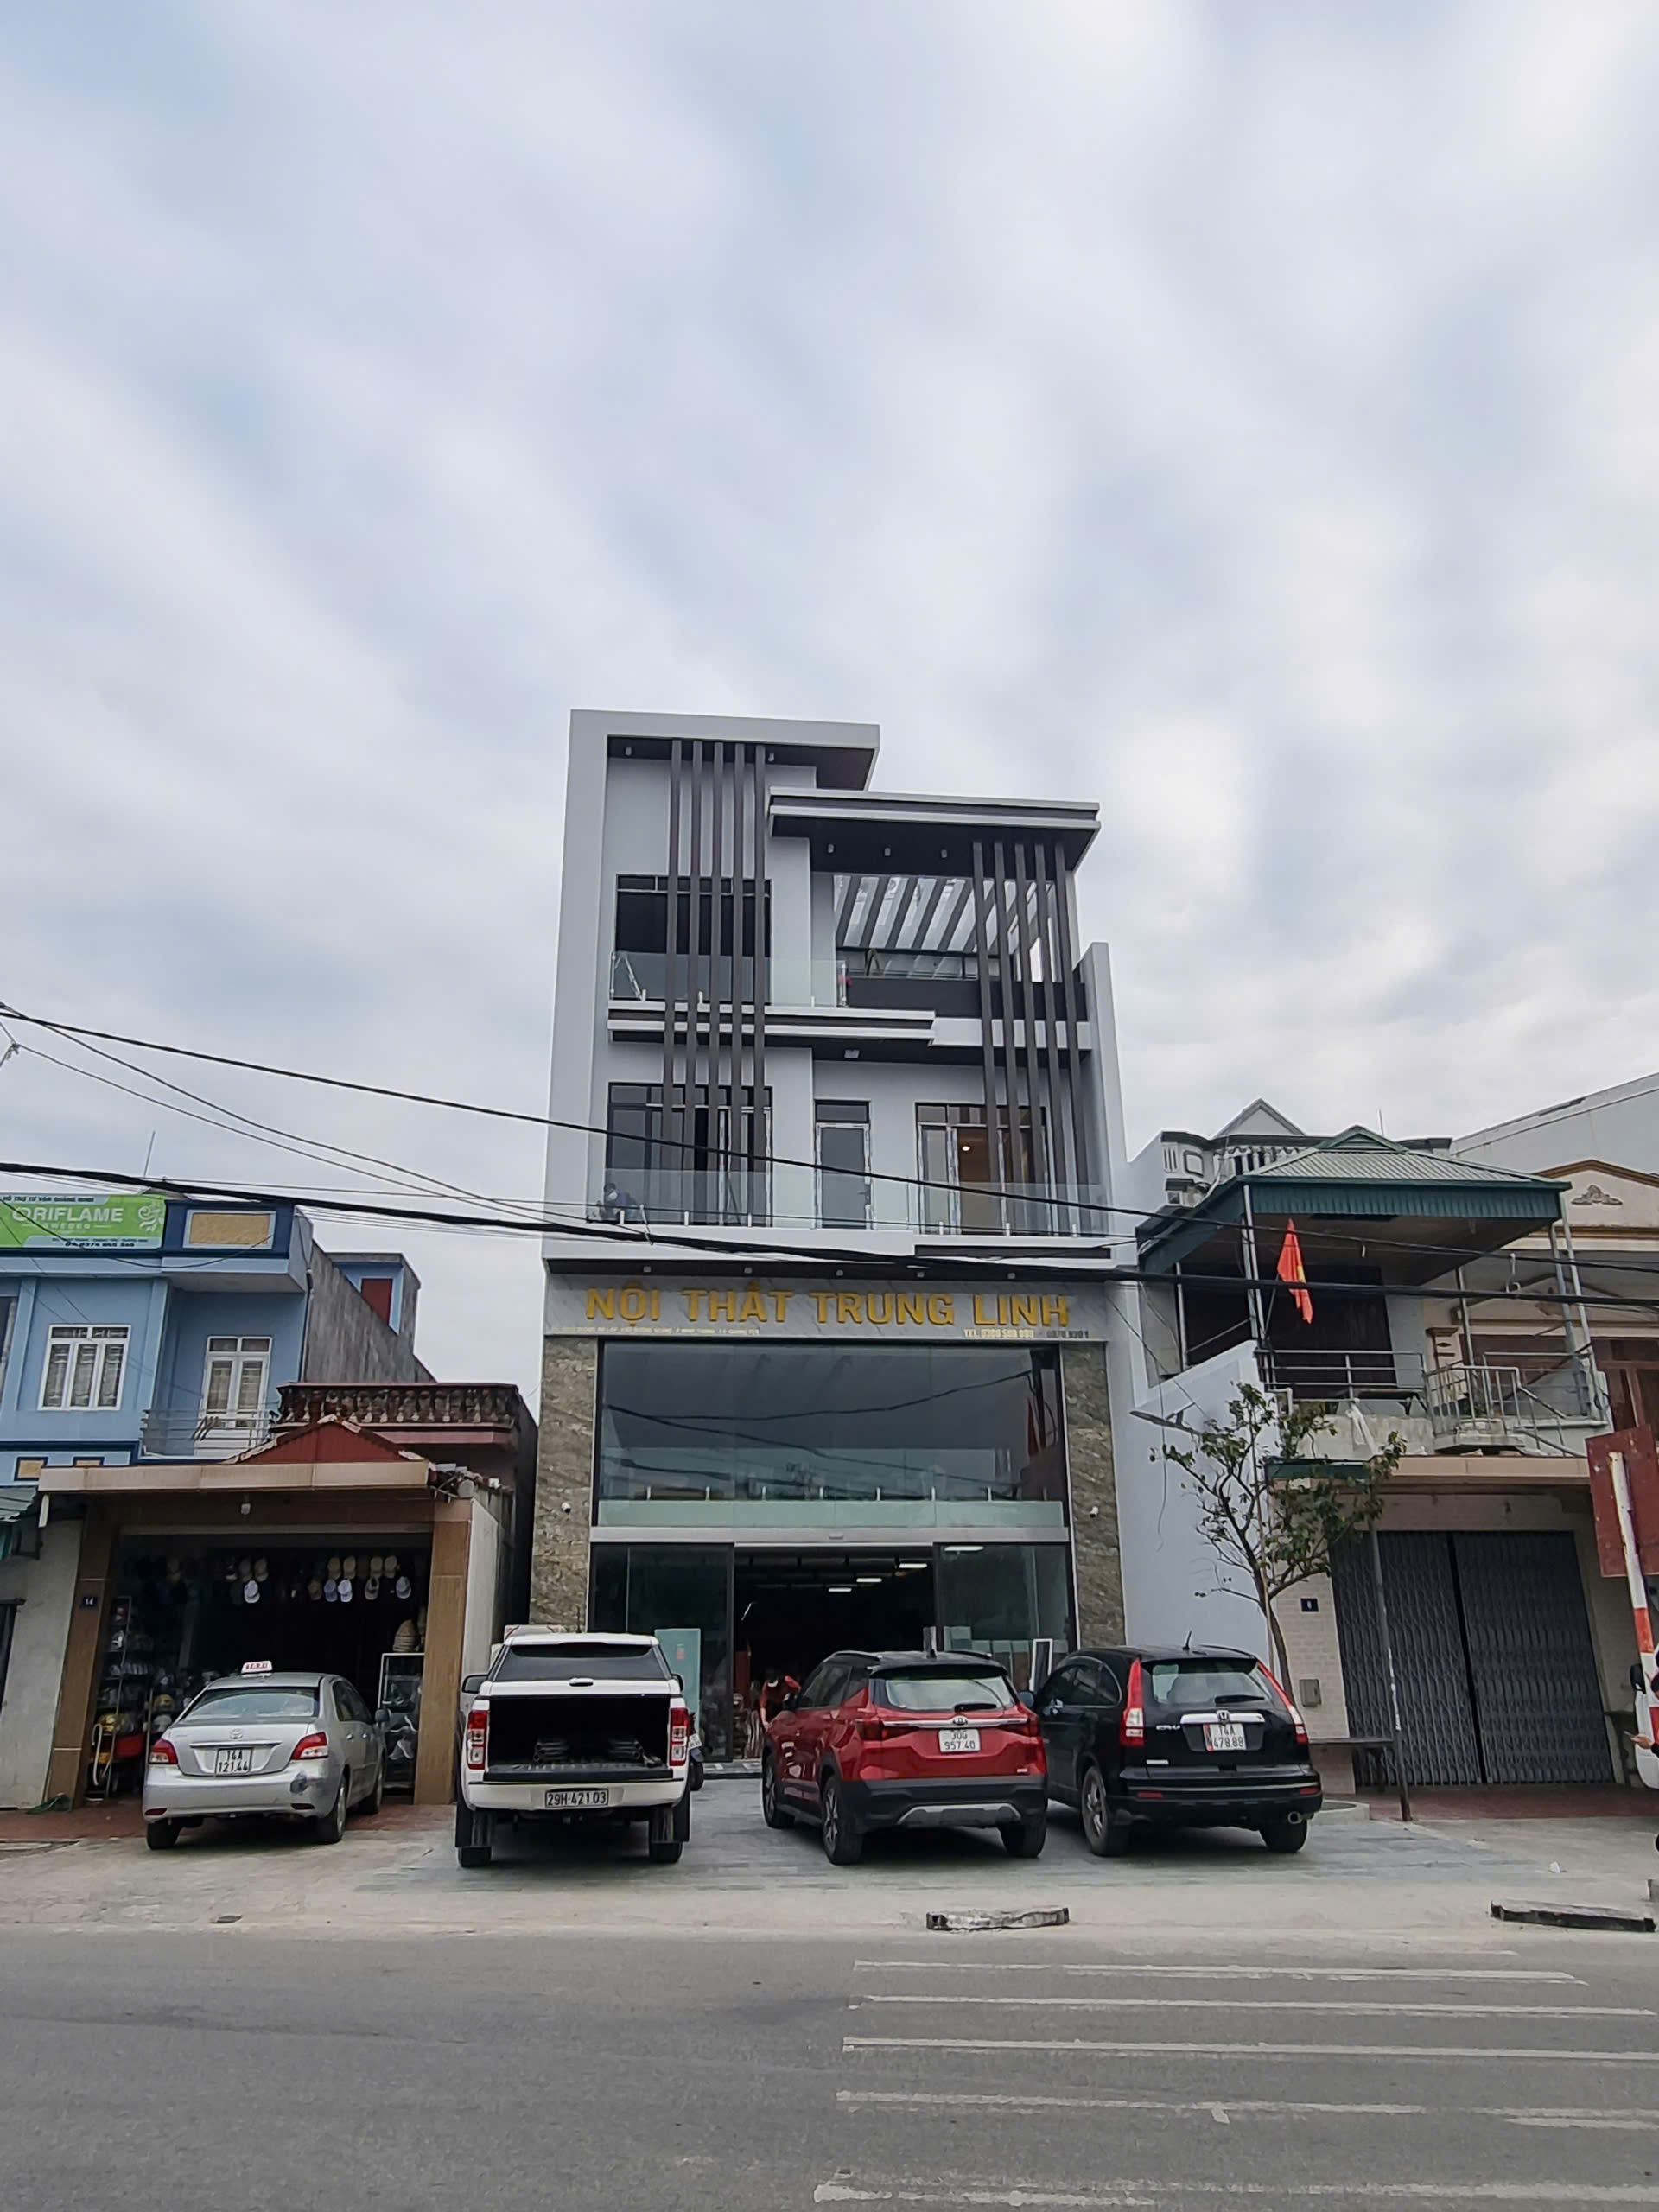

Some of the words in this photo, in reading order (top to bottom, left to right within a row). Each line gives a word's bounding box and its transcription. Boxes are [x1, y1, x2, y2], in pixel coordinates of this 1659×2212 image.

[11, 1207, 124, 1222] ORIFLAME
[587, 1281, 660, 1326] NỘI
[809, 1291, 955, 1326] TRUNG
[973, 1294, 1070, 1327] LINH
